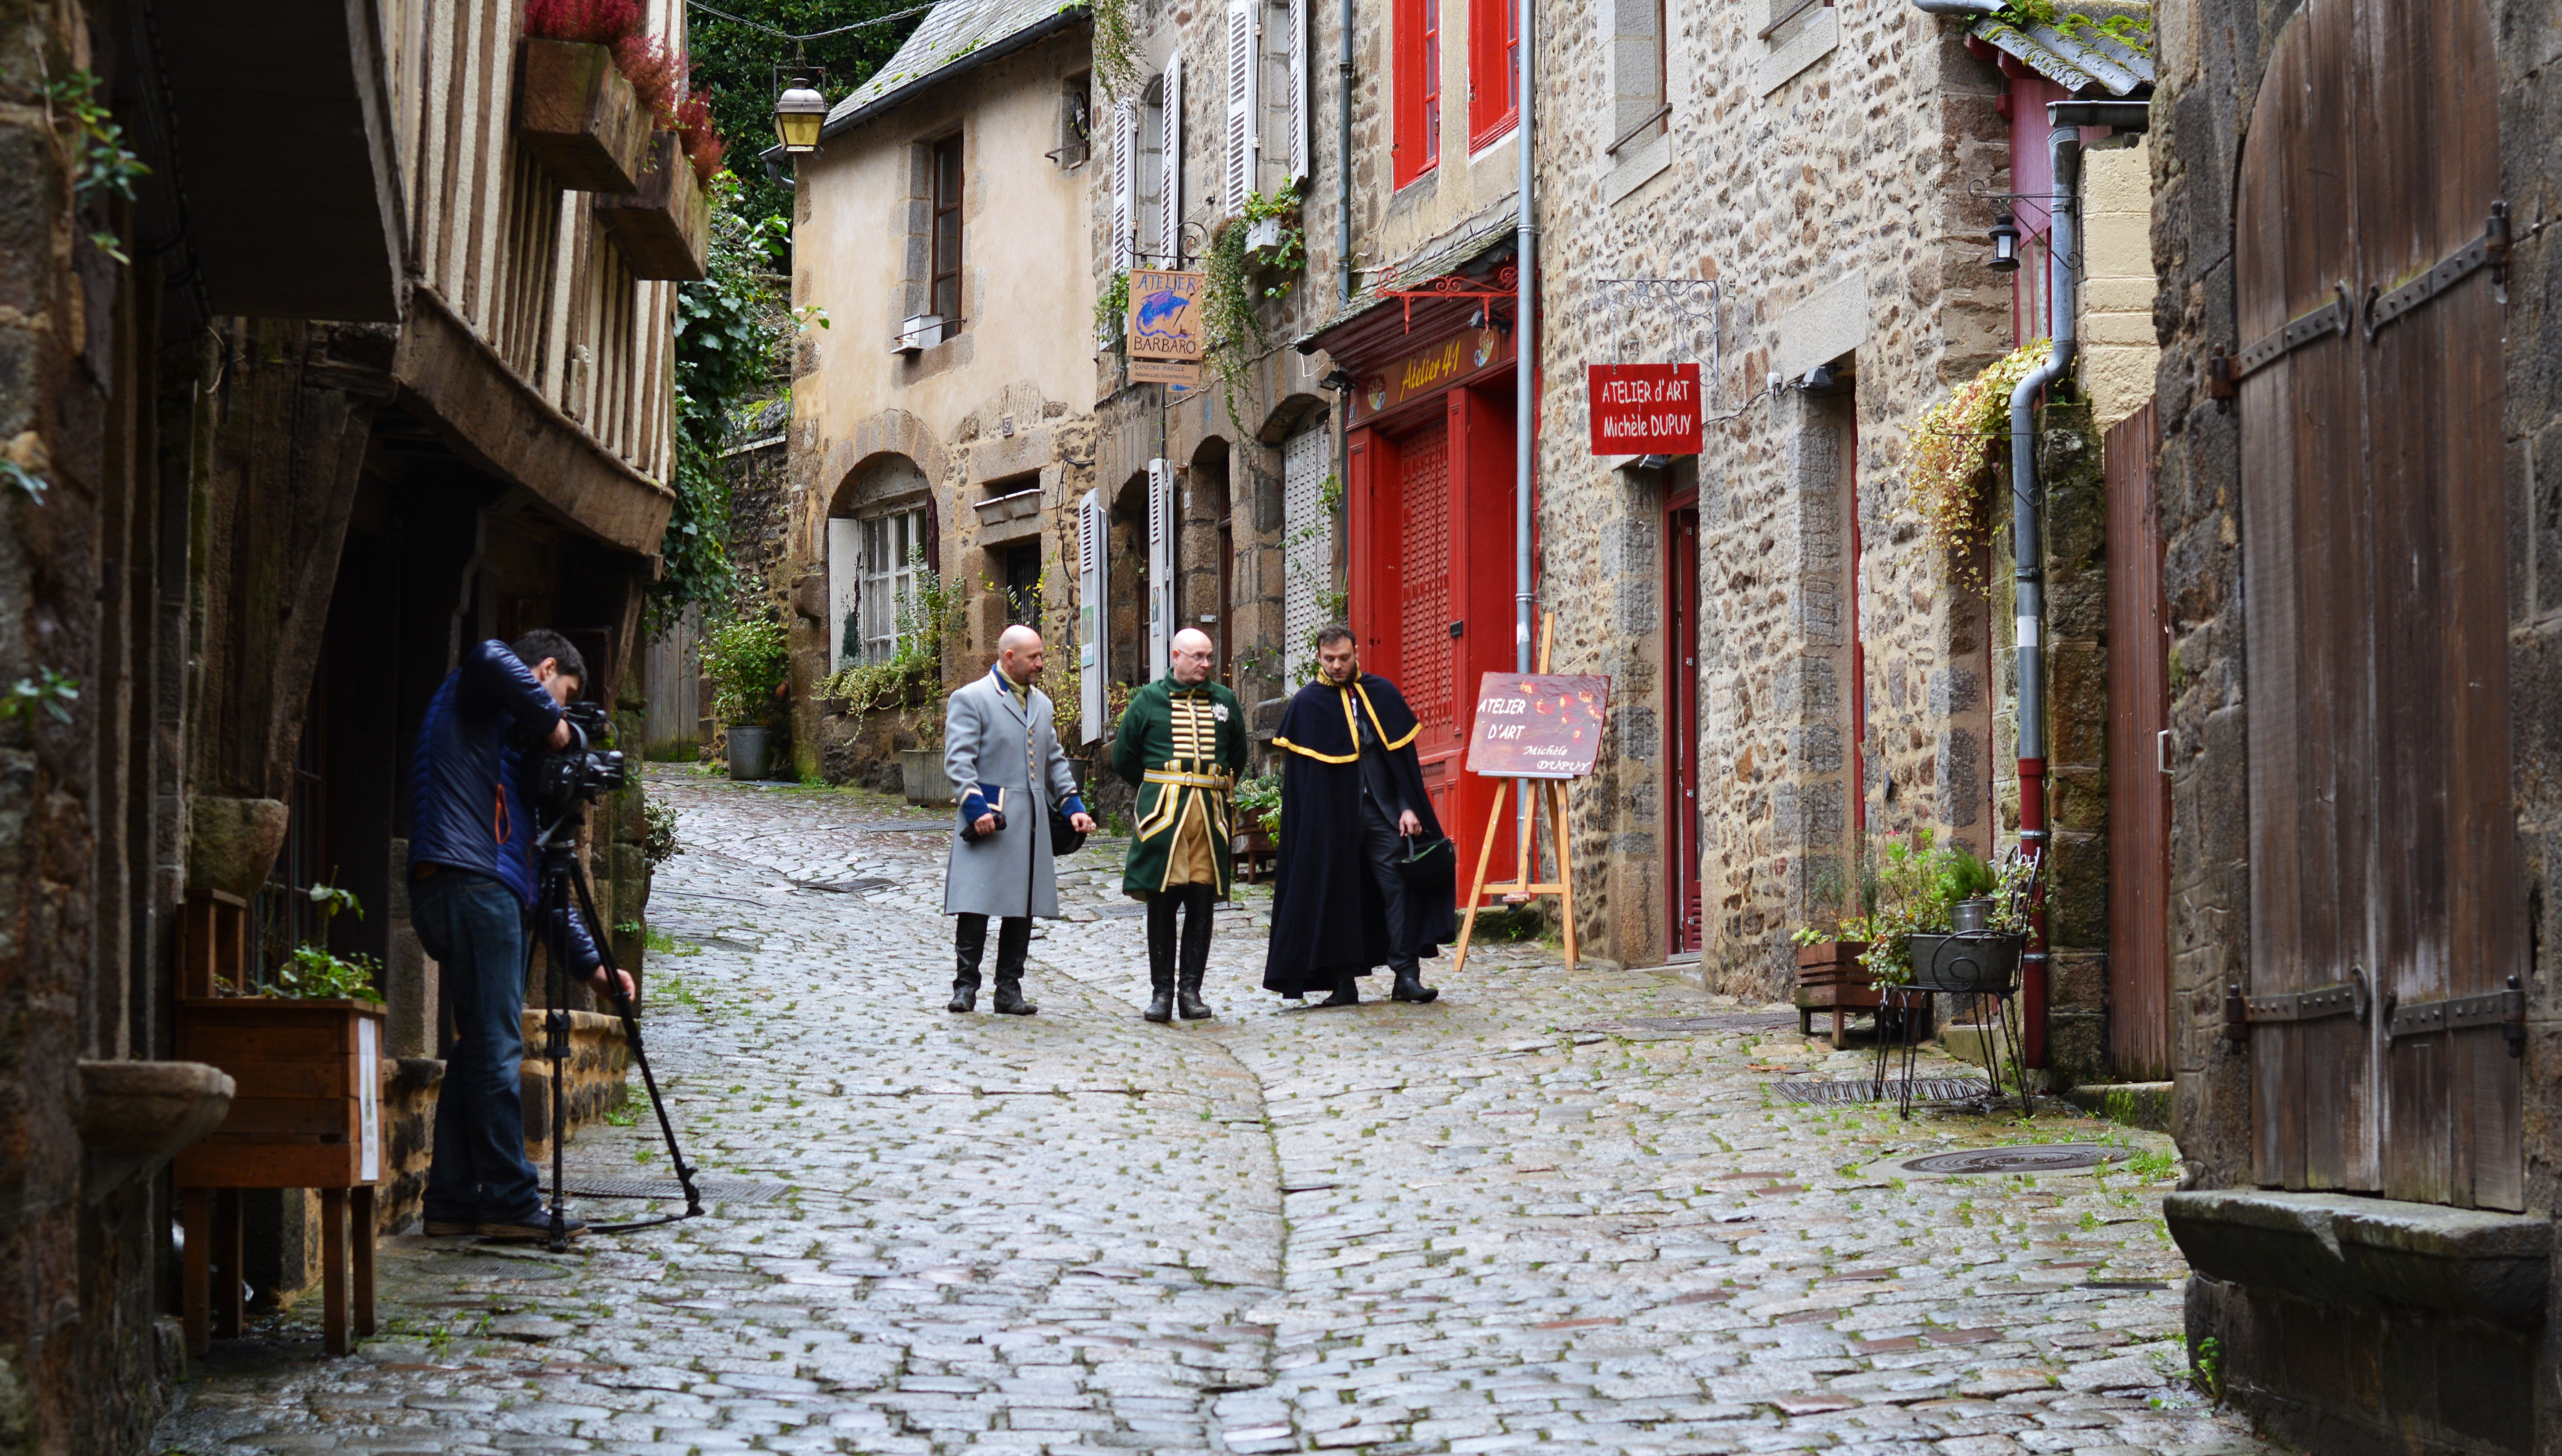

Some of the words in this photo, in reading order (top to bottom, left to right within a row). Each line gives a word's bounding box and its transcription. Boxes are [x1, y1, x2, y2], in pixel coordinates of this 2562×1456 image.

[1134, 336, 1196, 354] BARBARO
[1400, 358, 1440, 401] Atelier
[1442, 340, 1460, 377] 41
[1603, 380, 1652, 404] ATELIER
[1655, 378, 1689, 402] d'ART
[1604, 414, 1648, 437] Michèle
[1651, 413, 1691, 436] DUPUY
[1477, 698, 1526, 715] ATELIER
[1488, 724, 1525, 739] D'ART
[1523, 745, 1568, 756] Michèle
[1537, 760, 1591, 771] DUPUY
